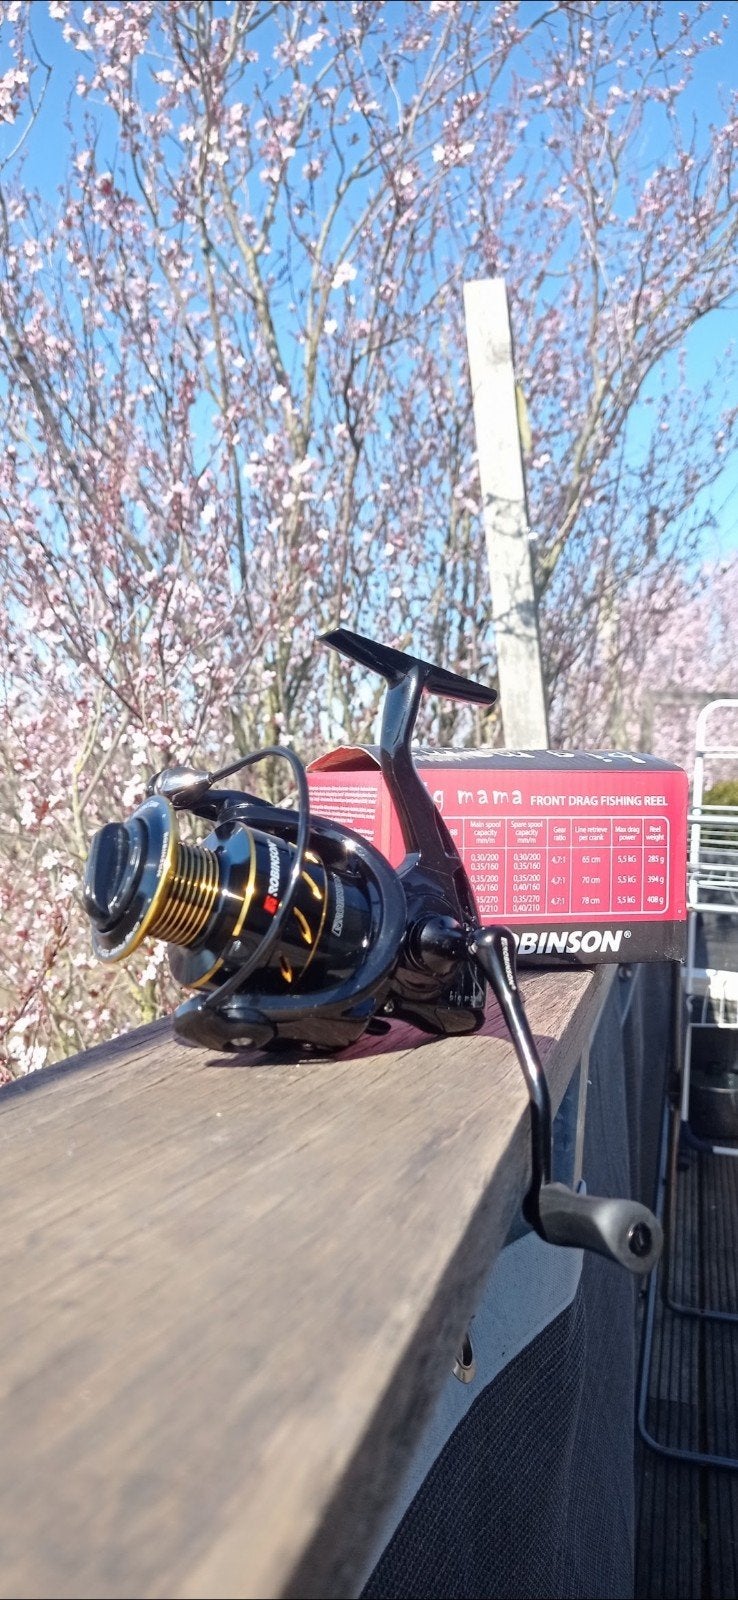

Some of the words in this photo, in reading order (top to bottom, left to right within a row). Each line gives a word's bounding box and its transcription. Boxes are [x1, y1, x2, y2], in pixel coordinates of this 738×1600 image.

[457, 790, 522, 805] mama
[530, 796, 566, 807] FRONT
[568, 796, 599, 807] DRAG
[601, 795, 642, 806] FISHING
[644, 795, 668, 806] REEL
[485, 821, 502, 829] spool
[511, 820, 526, 829] Spare
[527, 820, 543, 829] spool
[474, 829, 497, 838] capacity
[515, 828, 538, 837] capacity
[628, 826, 640, 835] drag
[619, 834, 636, 842] power
[646, 834, 664, 842] weight
[476, 895, 498, 903] 35/270
[581, 896, 589, 904] 78
